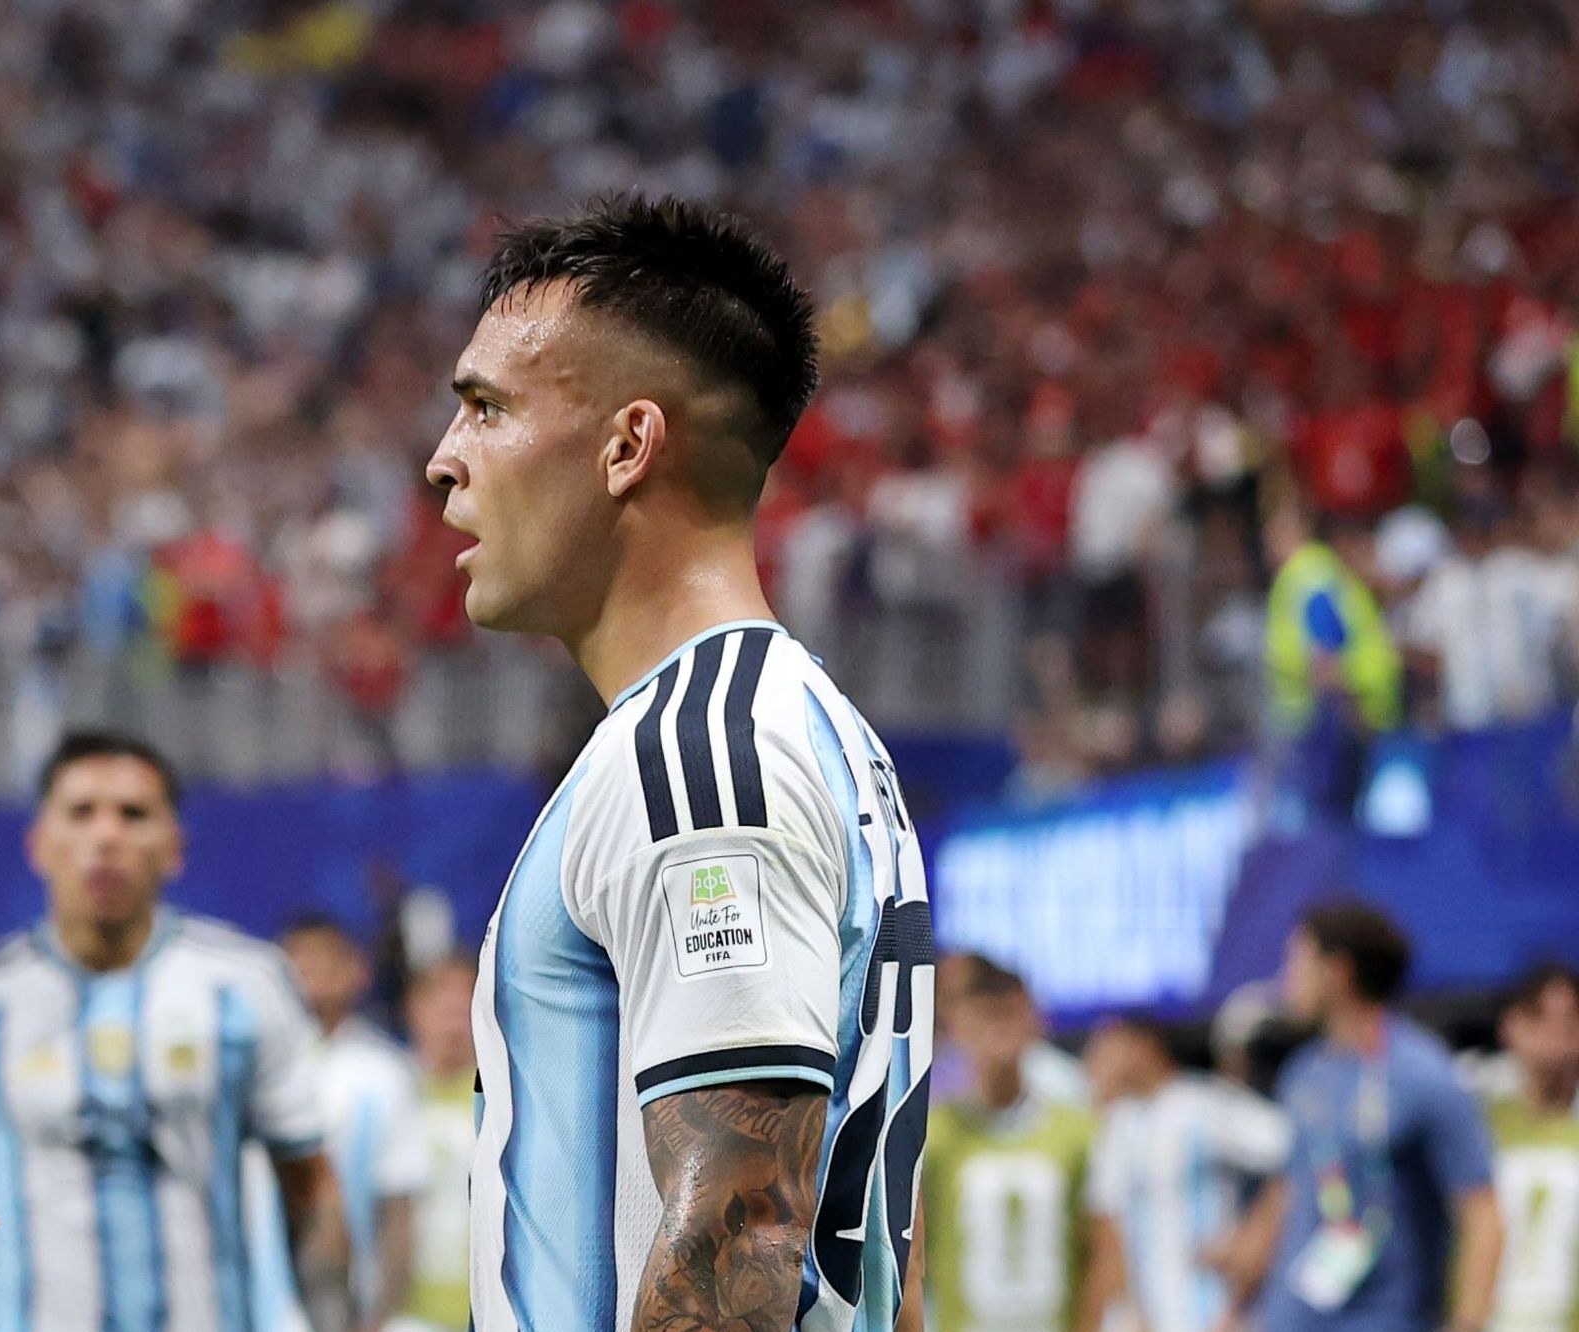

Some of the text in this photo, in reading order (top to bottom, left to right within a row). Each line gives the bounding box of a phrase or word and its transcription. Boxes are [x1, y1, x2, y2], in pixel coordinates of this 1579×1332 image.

[692, 904, 741, 930] Unite For
[685, 928, 753, 954] EDUCATION
[706, 950, 731, 963] FIFA
